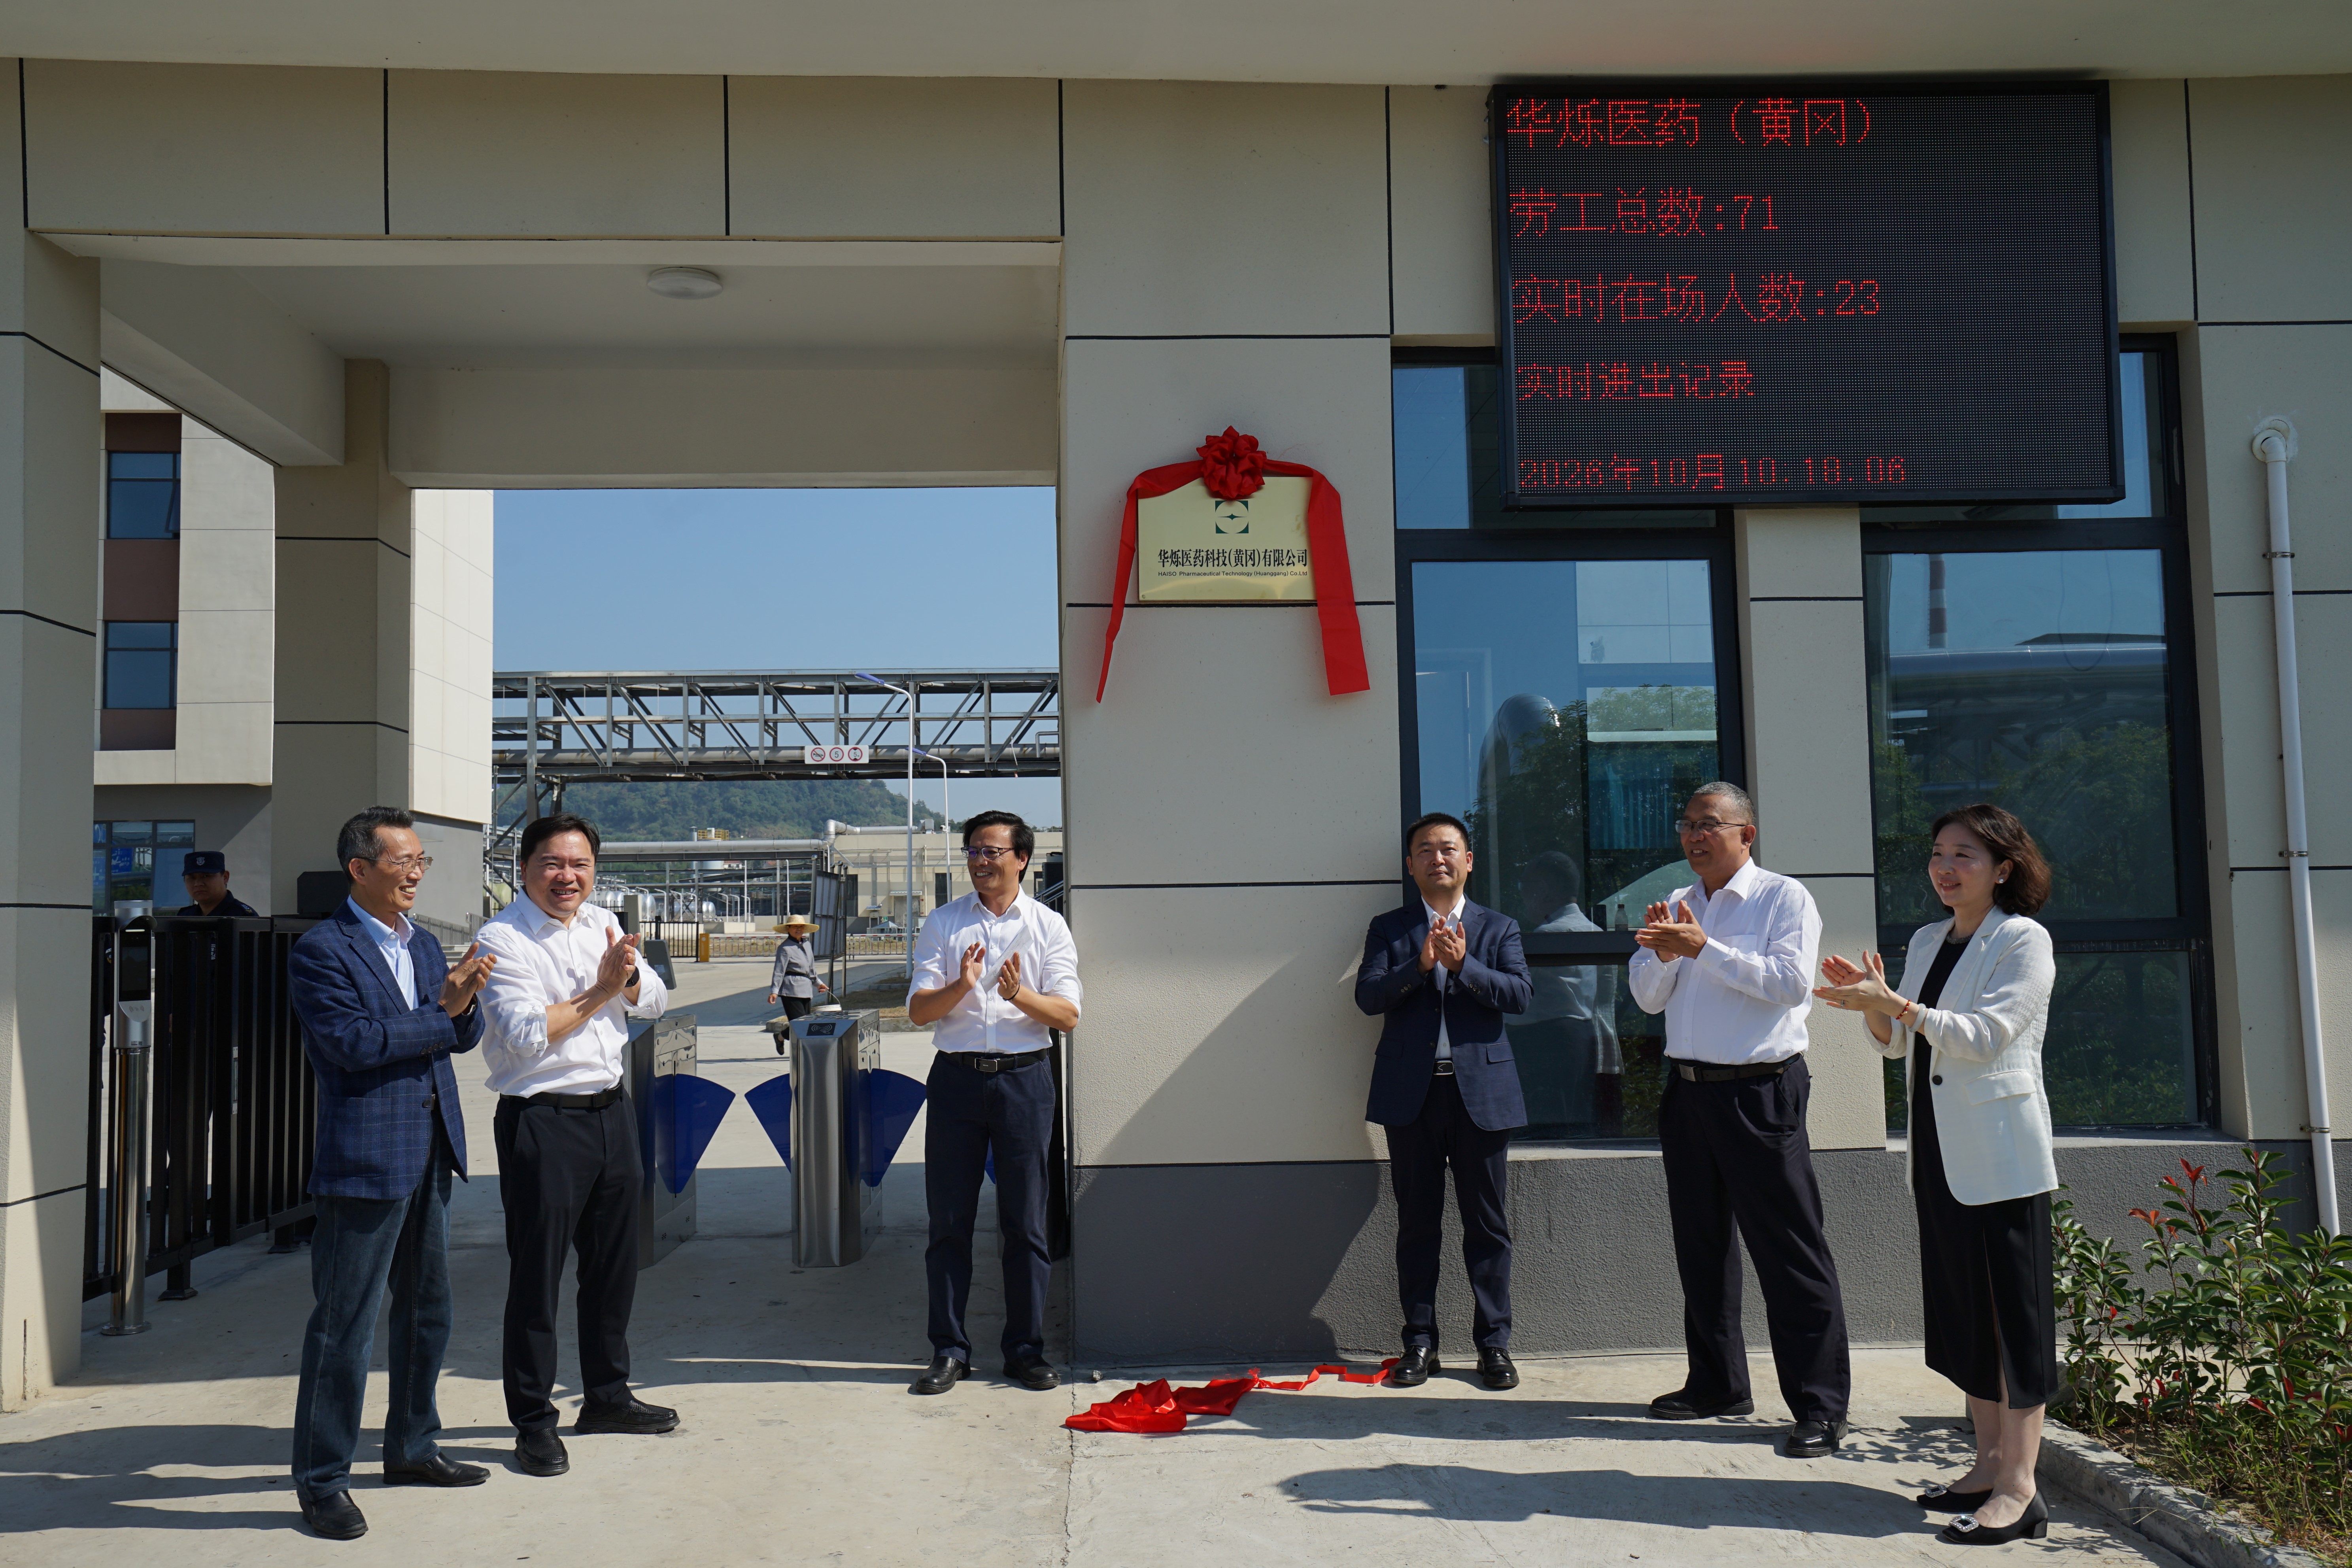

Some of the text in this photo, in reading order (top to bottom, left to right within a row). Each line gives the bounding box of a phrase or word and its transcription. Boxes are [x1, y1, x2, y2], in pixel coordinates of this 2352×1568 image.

[1507, 97, 1870, 148] 华烁医药（黄冈）
[1509, 187, 1779, 237] 劳工总数:71
[1512, 272, 1880, 323] 实时在场人数:23
[1517, 361, 1755, 401] 实时进出记录
[1158, 548, 1307, 568] 华烁医药科技(黄冈)有限公司
